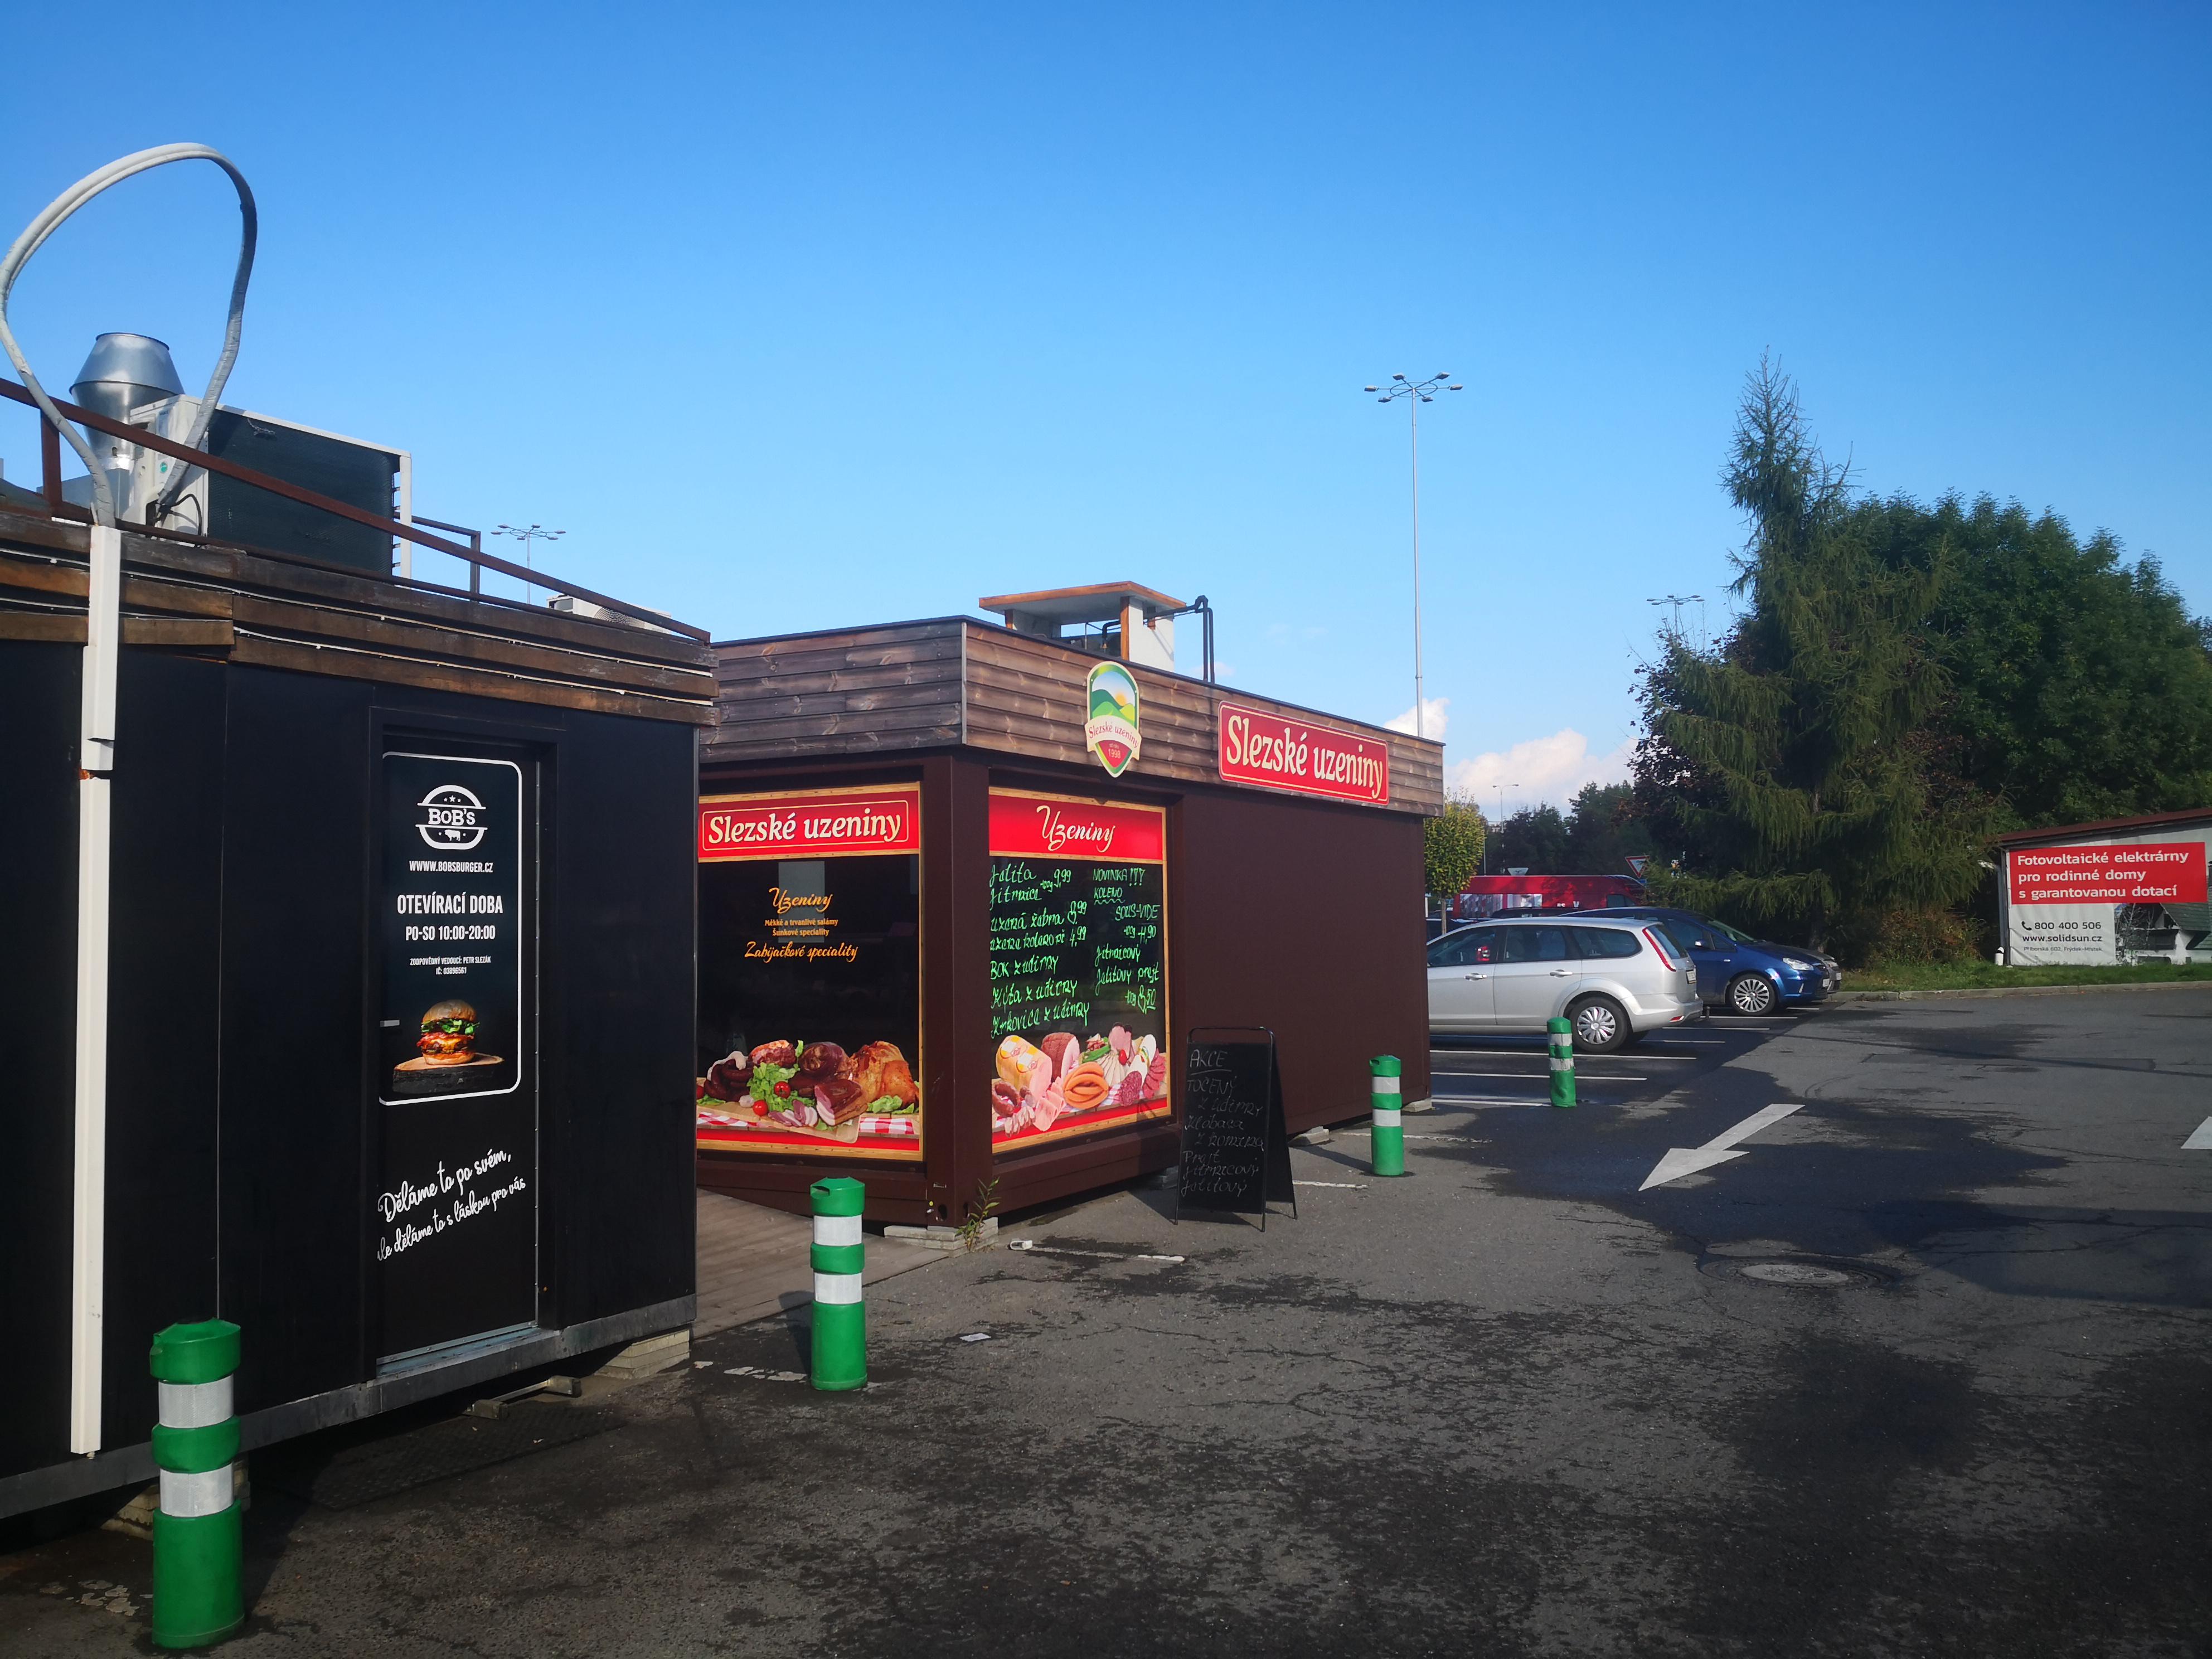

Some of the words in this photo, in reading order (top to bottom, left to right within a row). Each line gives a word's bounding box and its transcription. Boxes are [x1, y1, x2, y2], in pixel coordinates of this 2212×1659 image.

[1089, 721, 1112, 739] Slezské
[1115, 726, 1138, 748] uzeniny
[1226, 715, 1308, 776] Slezské
[1313, 744, 1383, 799] uzeniny
[708, 812, 796, 843] Slezské
[804, 808, 901, 842] uzeniny
[1036, 805, 1115, 853] Uzeniny
[2017, 851, 2109, 866] Fotovoltaické
[2114, 850, 2189, 864] elektrárny
[1093, 868, 1128, 882] NOVINKA
[2018, 873, 2040, 885] pro
[2046, 869, 2100, 882] rodinné
[2106, 869, 2146, 882] domy
[769, 887, 833, 914] Uzeniny
[1094, 887, 1123, 900] KOLENO
[2031, 887, 2126, 900] garantovanou
[2132, 884, 2177, 897] dotací
[397, 891, 466, 914] OTEVÍRACÍ
[470, 895, 503, 914] DOBA
[789, 918, 816, 926] trvanlivé
[817, 918, 838, 926] salámy
[405, 926, 435, 940] PO-SO
[438, 925, 496, 940] 10:00-20:00
[773, 928, 798, 937] Šunkové
[799, 928, 830, 937] speciality
[475, 955, 491, 963] SLEZÁK
[807, 942, 858, 963] speciality
[1190, 1049, 1228, 1068] AKCE
[377, 1180, 438, 1223] Děláme
[437, 1161, 454, 1194] to
[456, 1167, 473, 1196] po
[474, 1148, 511, 1175] svém,
[394, 1224, 433, 1251] děláme
[433, 1209, 445, 1233] to
[447, 1214, 453, 1226] s
[454, 1190, 491, 1223] láskou
[491, 1189, 508, 1212] pro
[509, 1176, 526, 1194] vás
